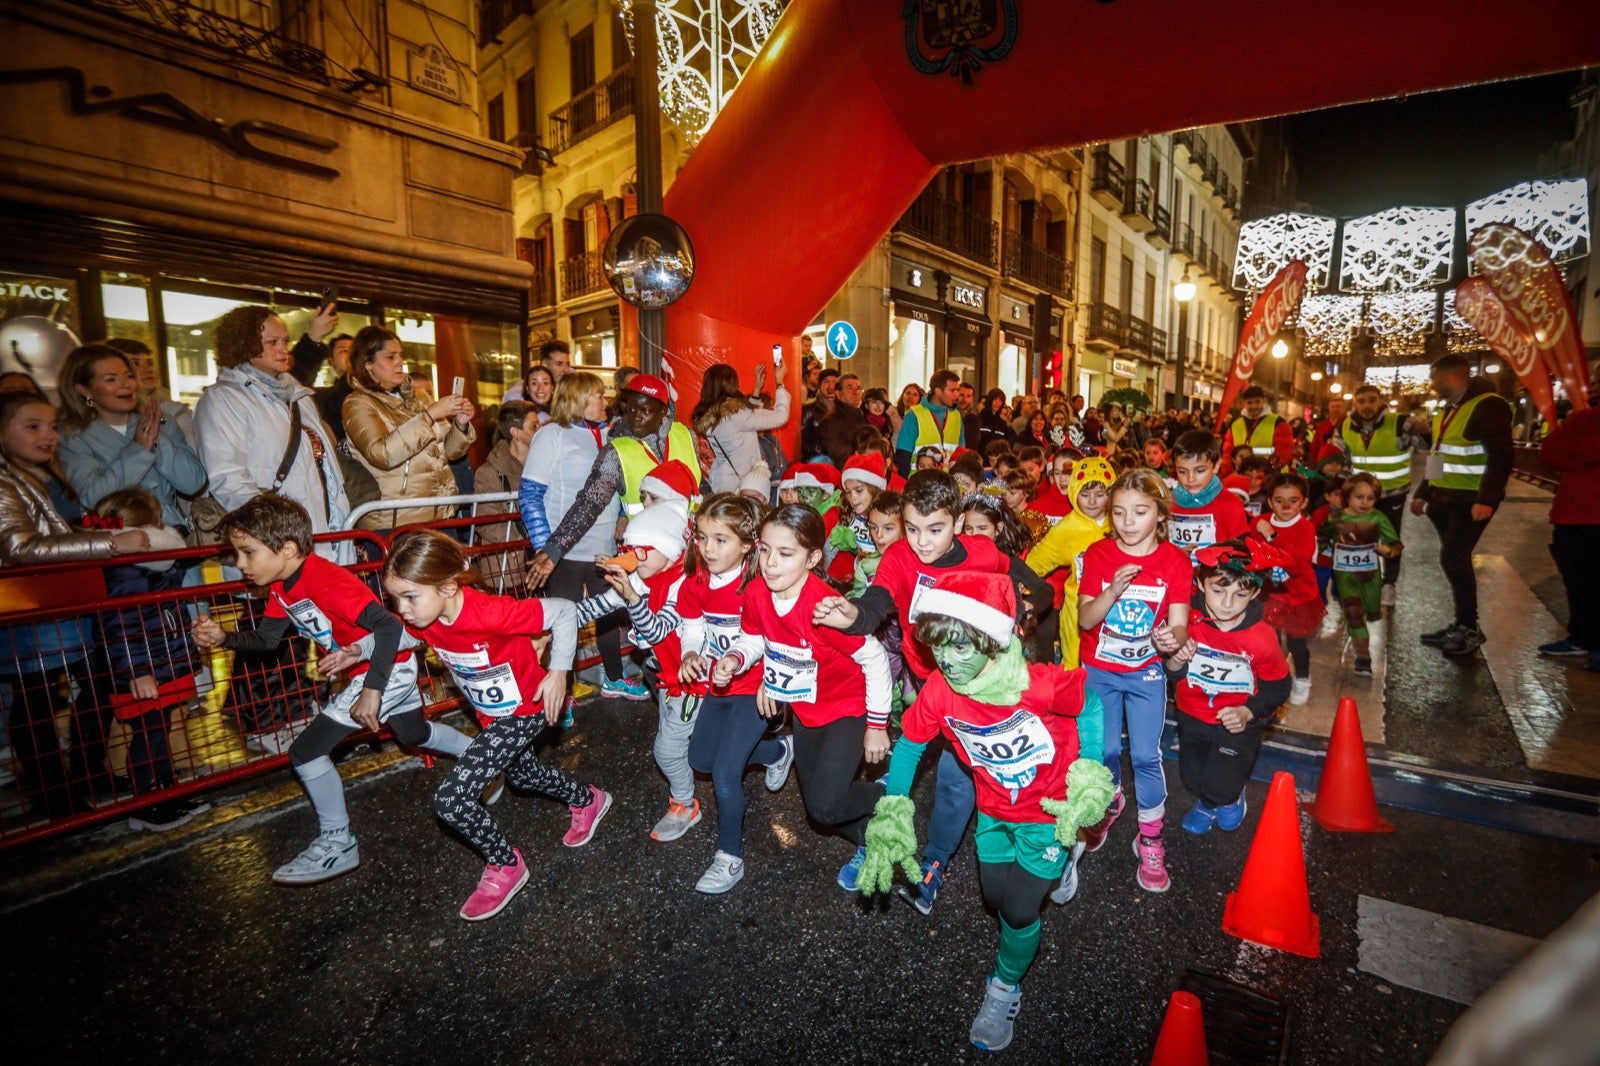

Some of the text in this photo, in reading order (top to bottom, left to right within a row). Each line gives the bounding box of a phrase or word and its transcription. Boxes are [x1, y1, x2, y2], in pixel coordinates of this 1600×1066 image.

[954, 286, 983, 308] TOUS
[912, 310, 929, 321] TOUS
[966, 323, 980, 333] TOUS
[641, 385, 658, 396] neff
[1175, 527, 1203, 542] 367
[1344, 555, 1370, 565] 194
[1120, 645, 1149, 659] 66
[764, 666, 794, 689] 37
[1200, 664, 1233, 681] 27
[463, 685, 505, 704] 179
[972, 734, 1035, 760] 302
